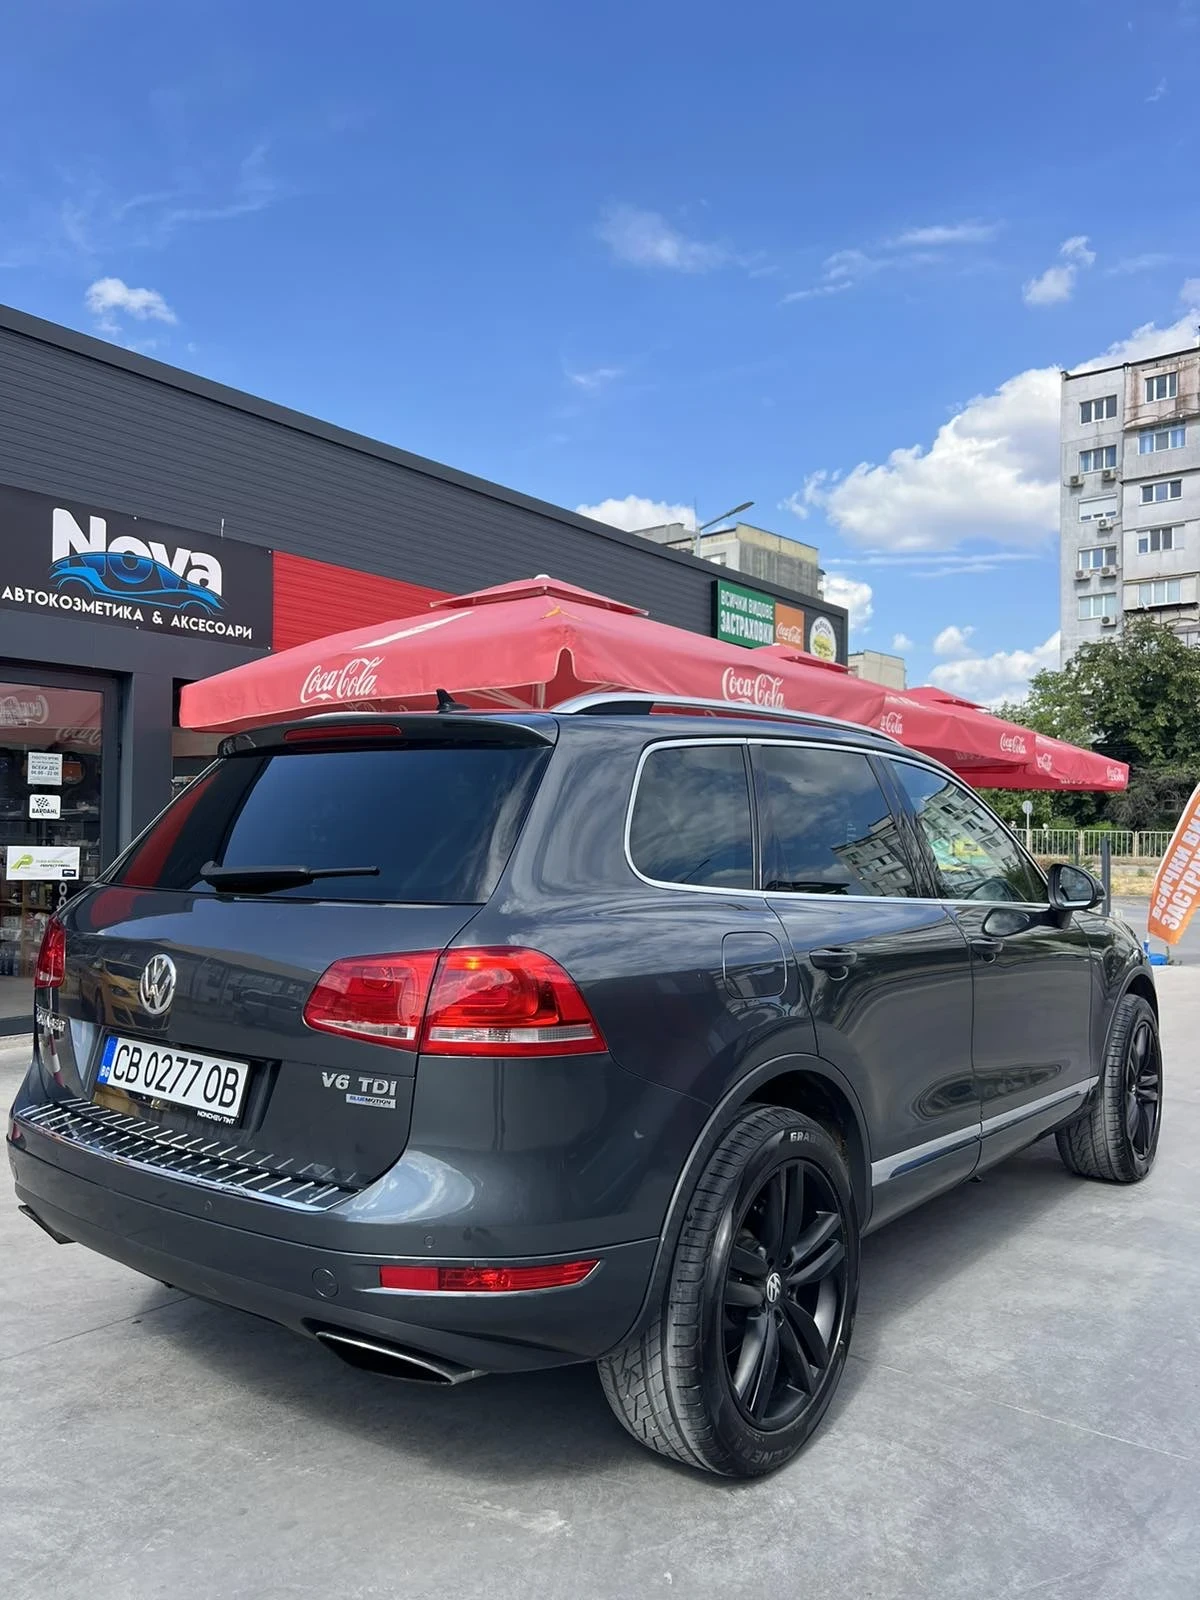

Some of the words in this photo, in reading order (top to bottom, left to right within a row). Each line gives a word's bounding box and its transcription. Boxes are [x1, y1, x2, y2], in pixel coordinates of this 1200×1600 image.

[52, 507, 222, 597] Nova
[1, 585, 144, 622] АВТОКОЗМЕТИКА
[152, 611, 163, 625] &
[171, 614, 253, 640] АКСЕСОАРИ
[300, 656, 385, 704] Coca-Cola
[722, 666, 785, 708] Coca-Cola
[1152, 844, 1193, 921] ВСИЧКИ
[100, 1065, 111, 1078] BG
[113, 1044, 142, 1084] CB
[144, 1051, 203, 1098] 0277
[321, 1071, 350, 1090] V6
[358, 1076, 397, 1096] TDI
